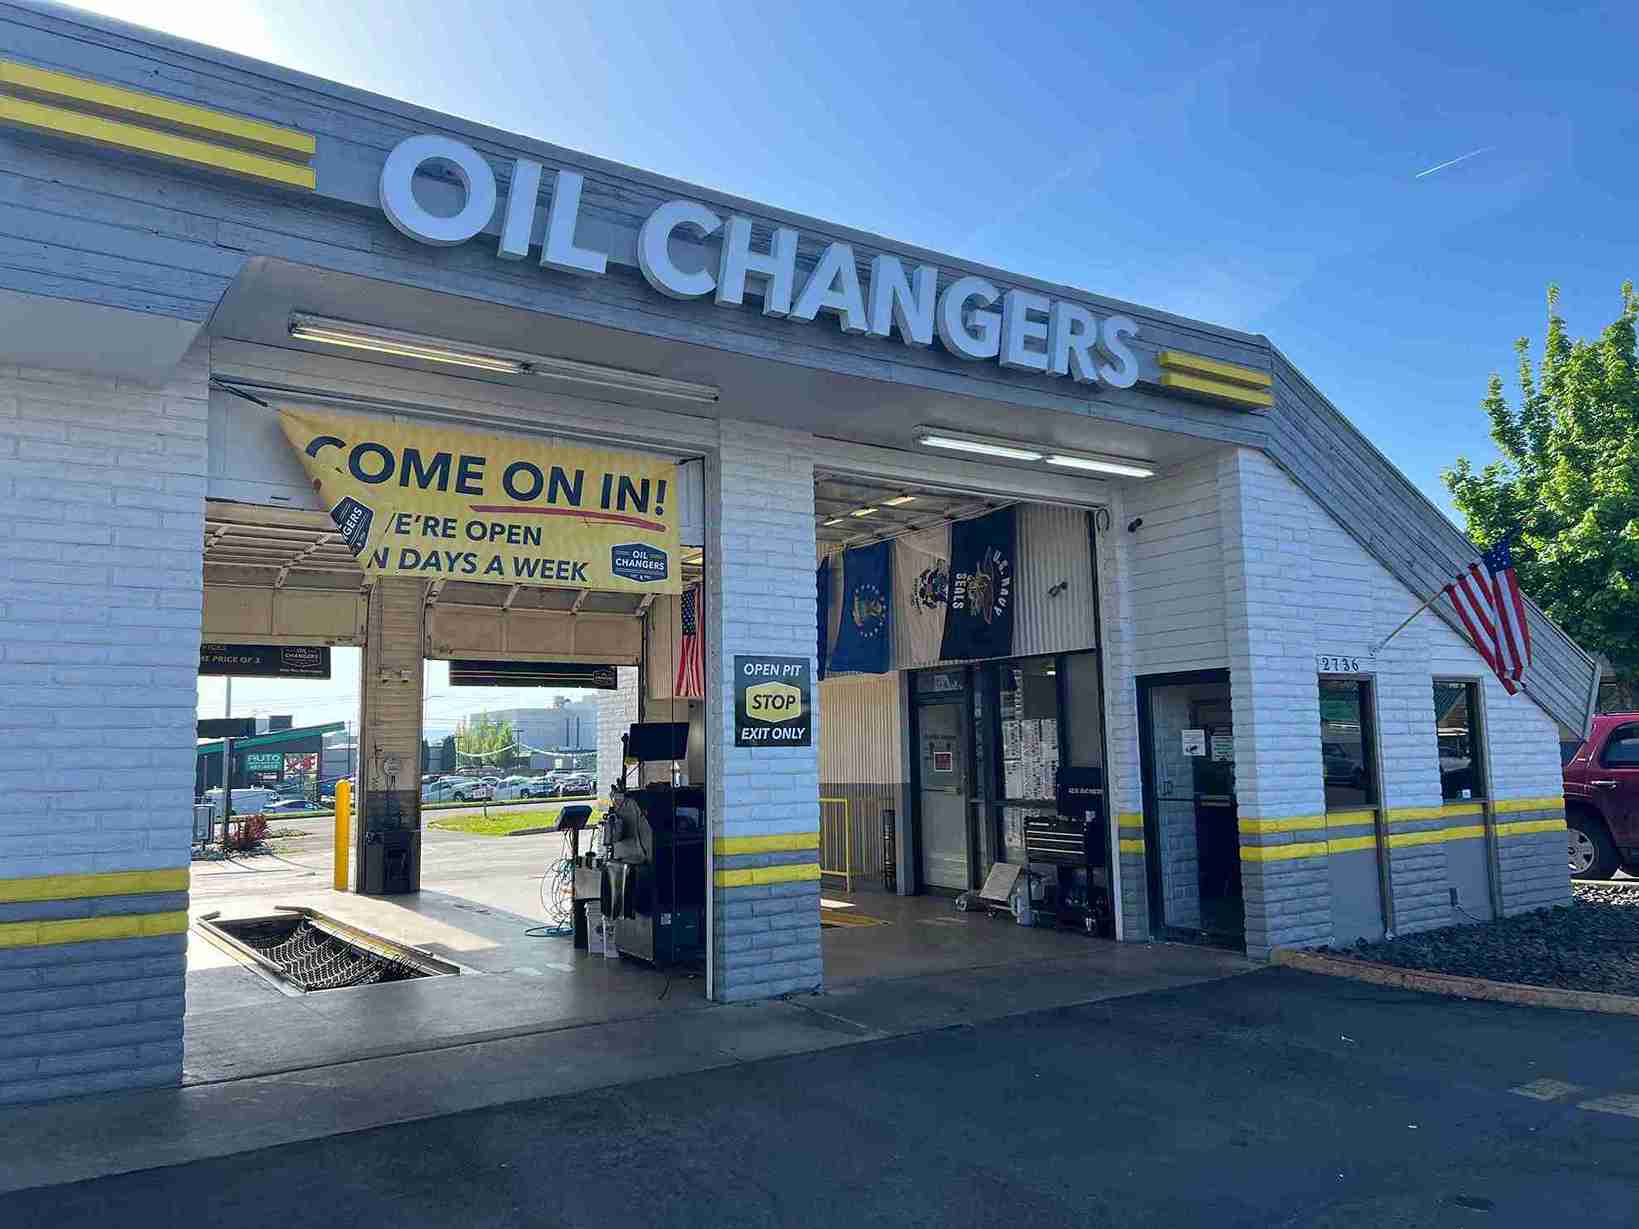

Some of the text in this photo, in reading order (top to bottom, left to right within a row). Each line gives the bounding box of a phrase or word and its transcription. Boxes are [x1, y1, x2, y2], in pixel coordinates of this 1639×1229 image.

[379, 134, 1139, 389] OIL CHANGERS
[502, 461, 585, 507] ON
[600, 472, 667, 516] IN!
[385, 512, 542, 546] E'RE OPEN
[632, 550, 649, 559] OIL
[399, 547, 478, 574] DAYS
[484, 554, 505, 576] A
[512, 556, 590, 582] WEEK
[615, 558, 665, 570] CHANGERS
[744, 663, 803, 677] OPEN PIT
[1319, 657, 1360, 672] 2736
[752, 694, 796, 710] STOP
[741, 727, 806, 740] EXIT ONLY
[248, 754, 281, 762] AUTO
